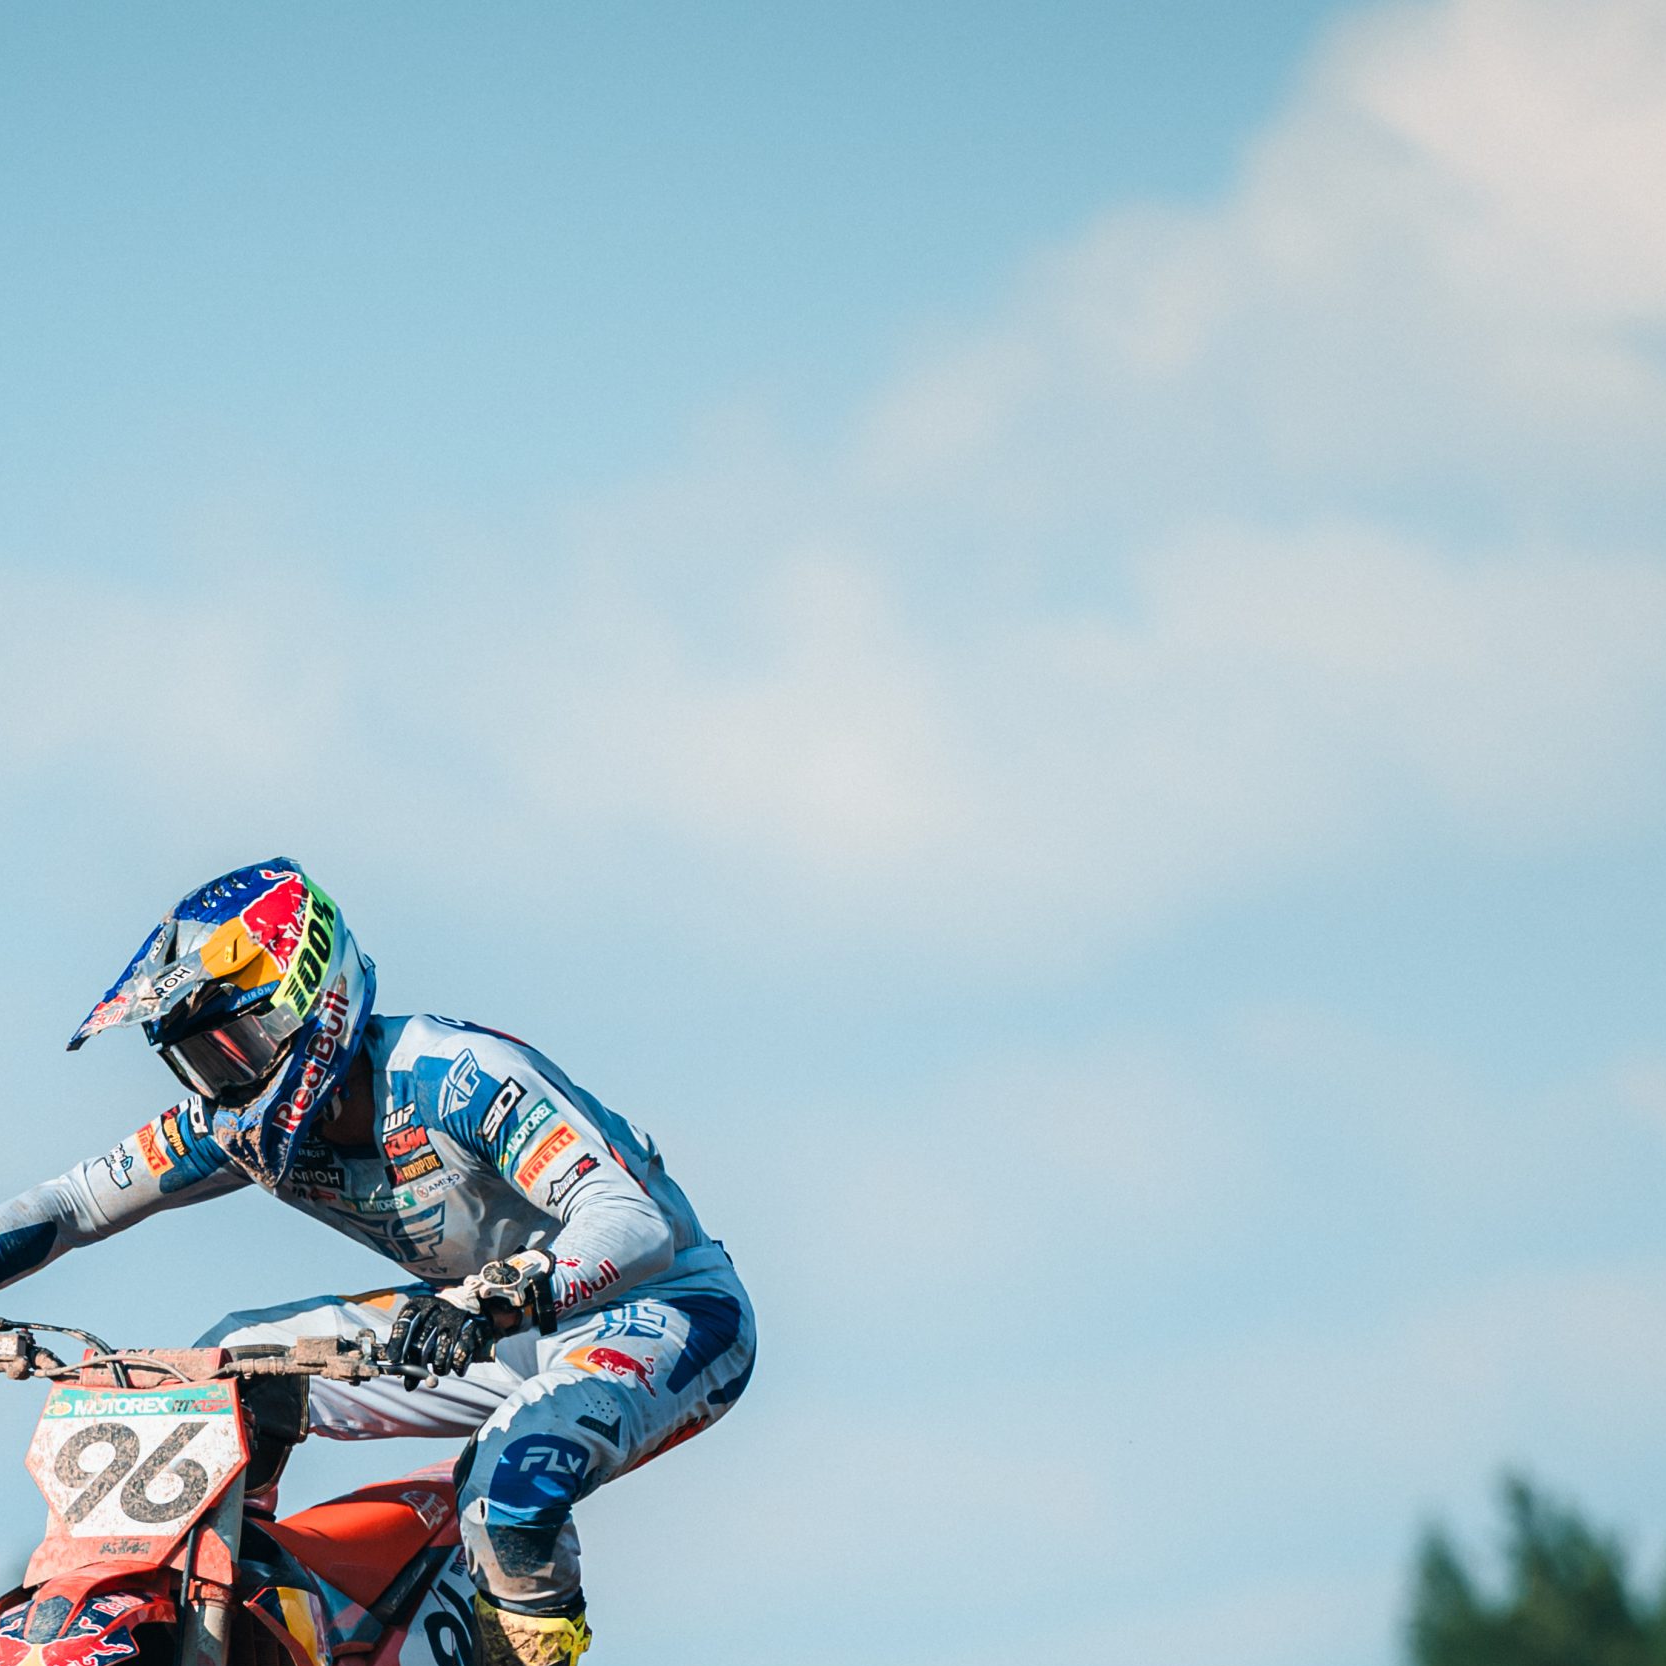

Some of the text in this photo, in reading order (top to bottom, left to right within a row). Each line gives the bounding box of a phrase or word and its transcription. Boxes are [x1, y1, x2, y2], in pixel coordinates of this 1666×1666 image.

[272, 1060, 327, 1134] Red
[305, 990, 350, 1066] Bull
[384, 1125, 428, 1159] KTM
[517, 1126, 576, 1188] PIRELLI
[553, 1280, 579, 1317] ed
[73, 1397, 171, 1417] MOTOREX
[54, 1421, 210, 1524] 96
[519, 1446, 584, 1474] FLY
